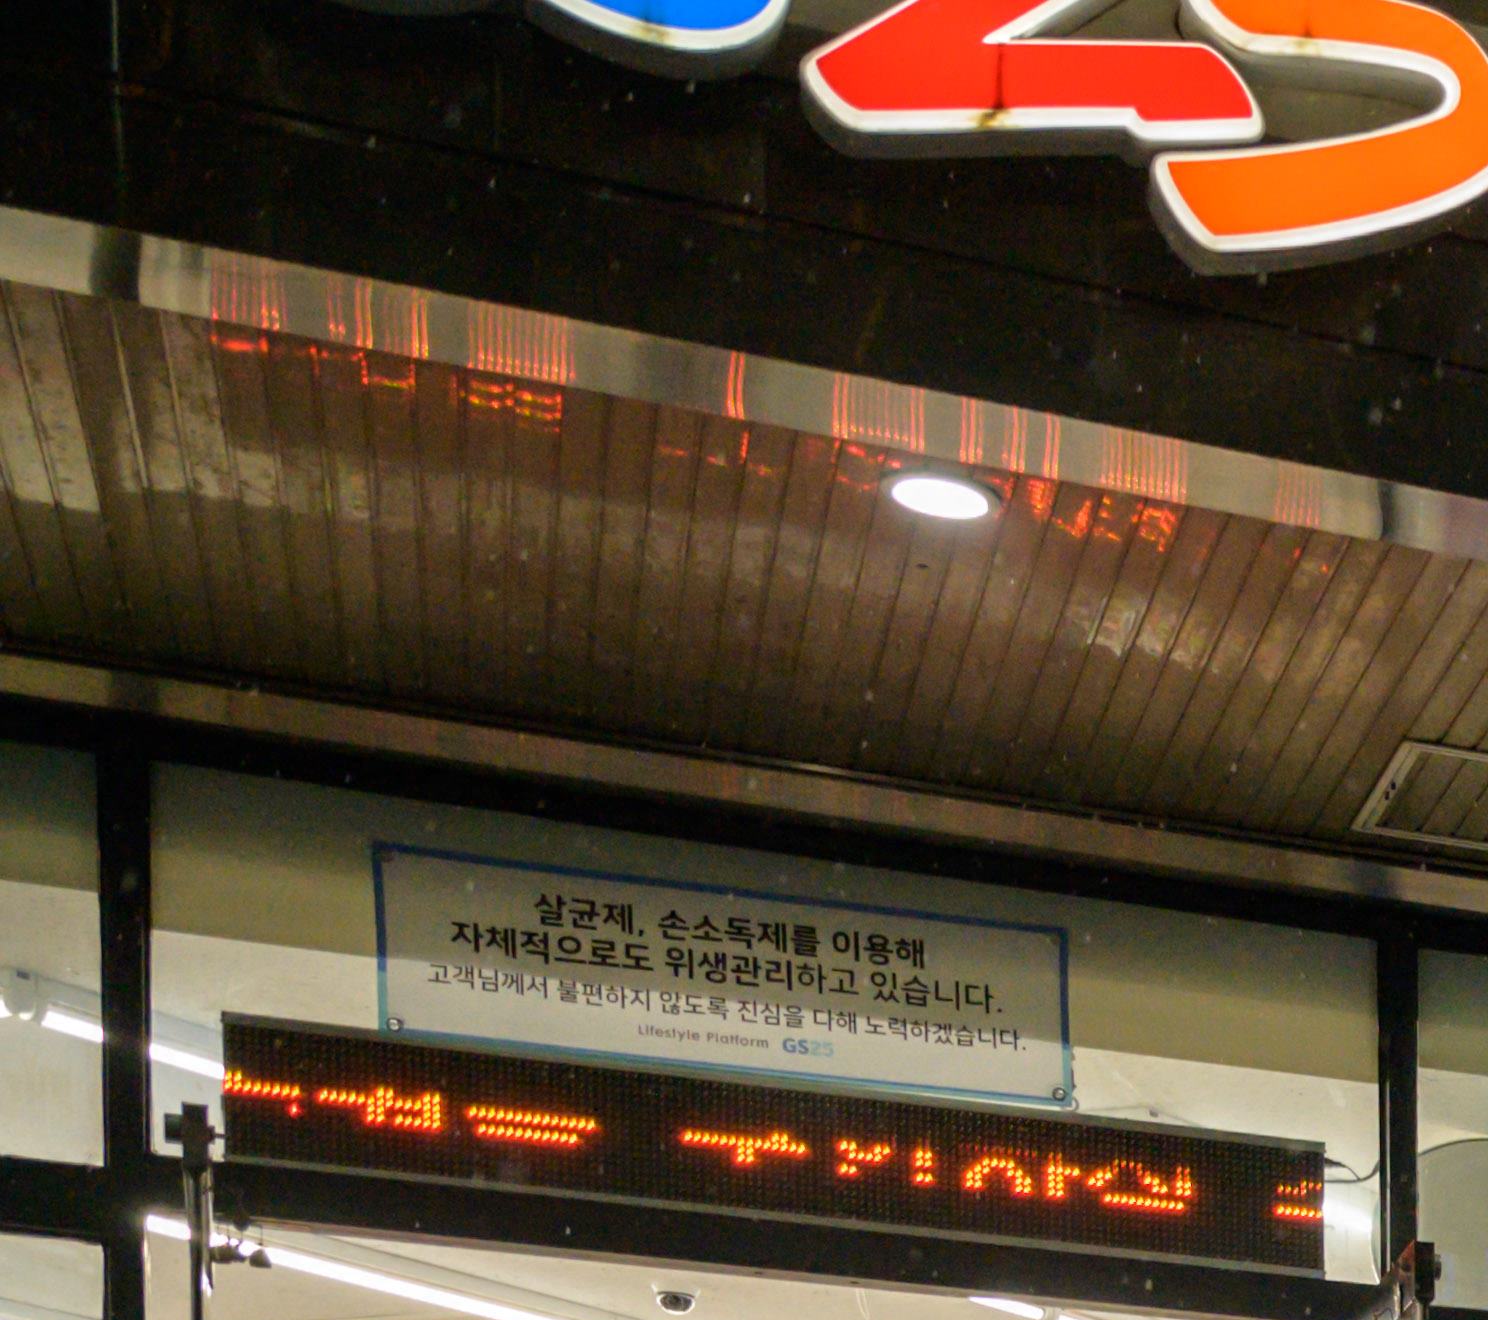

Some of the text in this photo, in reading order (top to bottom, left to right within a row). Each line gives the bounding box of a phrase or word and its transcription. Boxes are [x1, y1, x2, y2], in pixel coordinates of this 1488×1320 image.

[450, 920, 1003, 1014] 자체적으로도 위생관리하고 있습니다.
[534, 892, 926, 970] 살균제, 손소독제를 이용해
[427, 962, 1027, 1051] 고객님께서 불편하지 않도록 진심을 다해 노력하겠습니다.
[637, 1023, 835, 1058] Lifestyle Platform GS25
